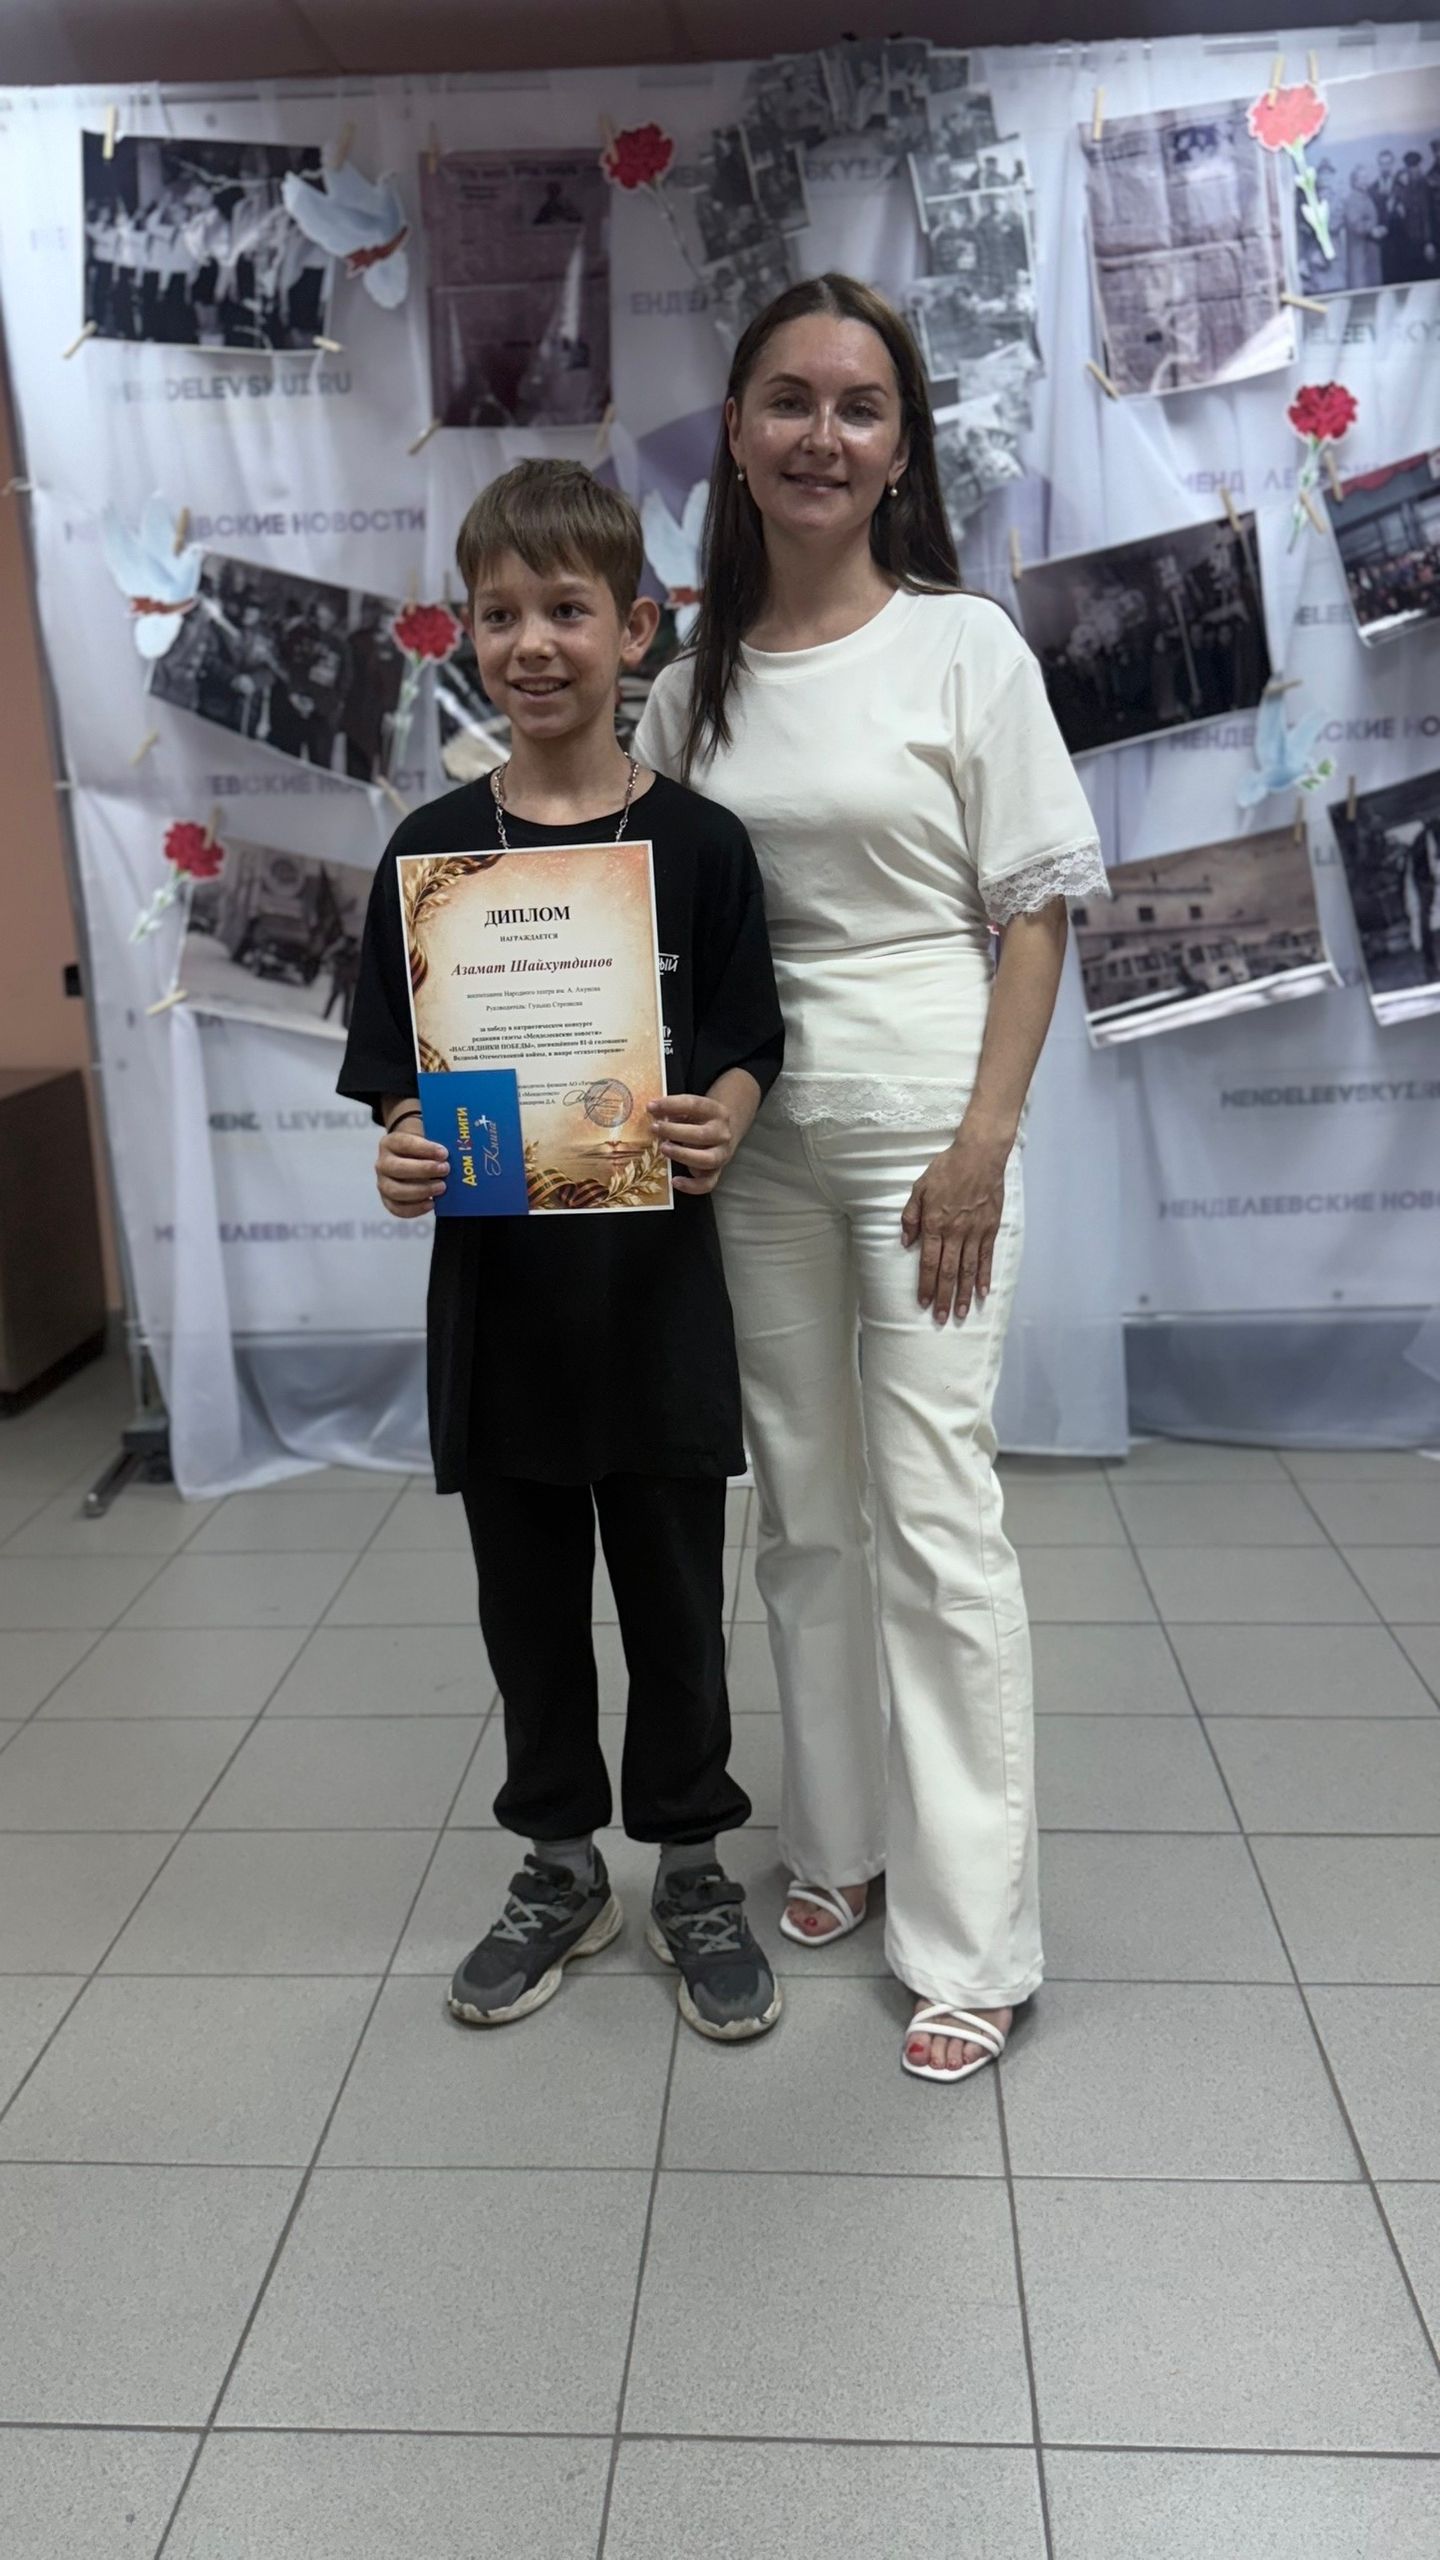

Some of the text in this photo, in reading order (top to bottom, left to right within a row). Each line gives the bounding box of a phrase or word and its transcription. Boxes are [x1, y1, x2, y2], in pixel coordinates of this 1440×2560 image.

[293, 508, 425, 535] НОВОСТИ
[484, 905, 570, 927] ДИПЛОМ
[500, 933, 558, 942] НАГРАЖДАЕТСЯ
[451, 957, 613, 976] Азамат Шайхутдинов
[449, 1043, 500, 1052] «НАСЛЕДНИКИ
[501, 1042, 536, 1050] ПОБЕДЫ»,
[479, 1052, 524, 1060] Отечественной
